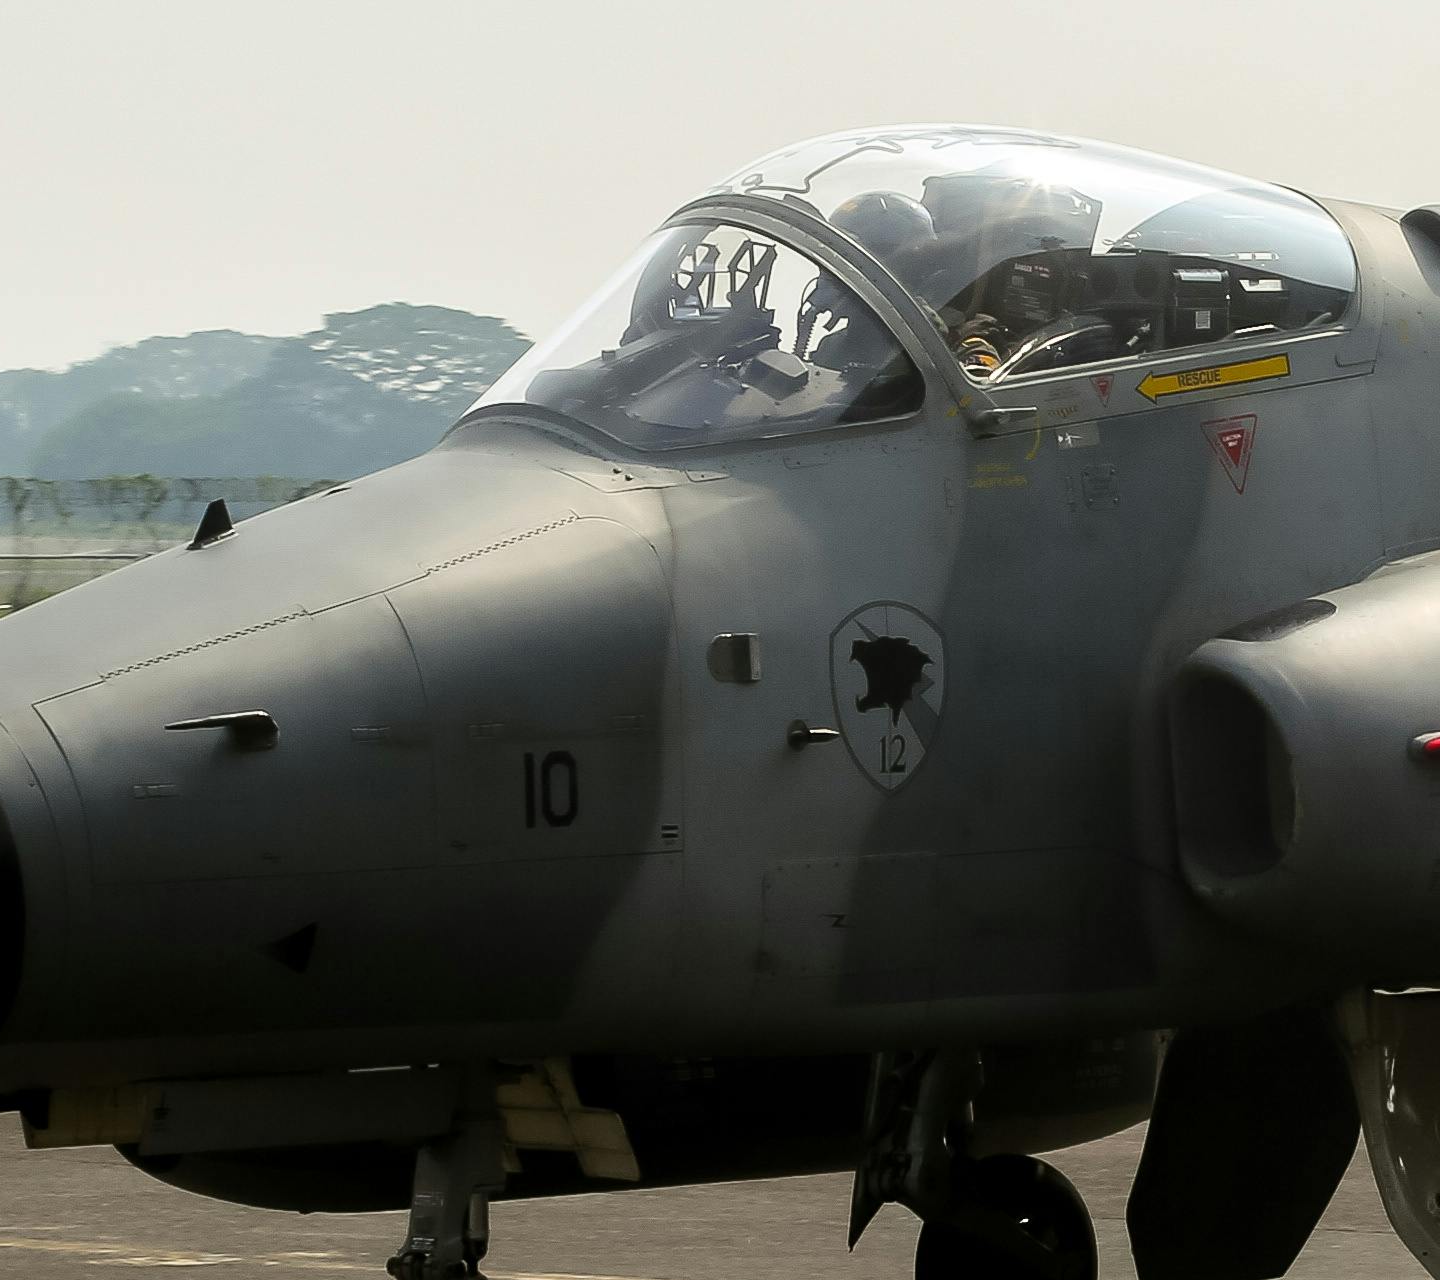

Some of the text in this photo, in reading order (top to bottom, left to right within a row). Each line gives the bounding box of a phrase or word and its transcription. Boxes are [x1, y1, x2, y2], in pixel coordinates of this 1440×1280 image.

[1177, 369, 1221, 388] RESCUE
[879, 734, 907, 774] 12
[523, 750, 579, 829] 10
